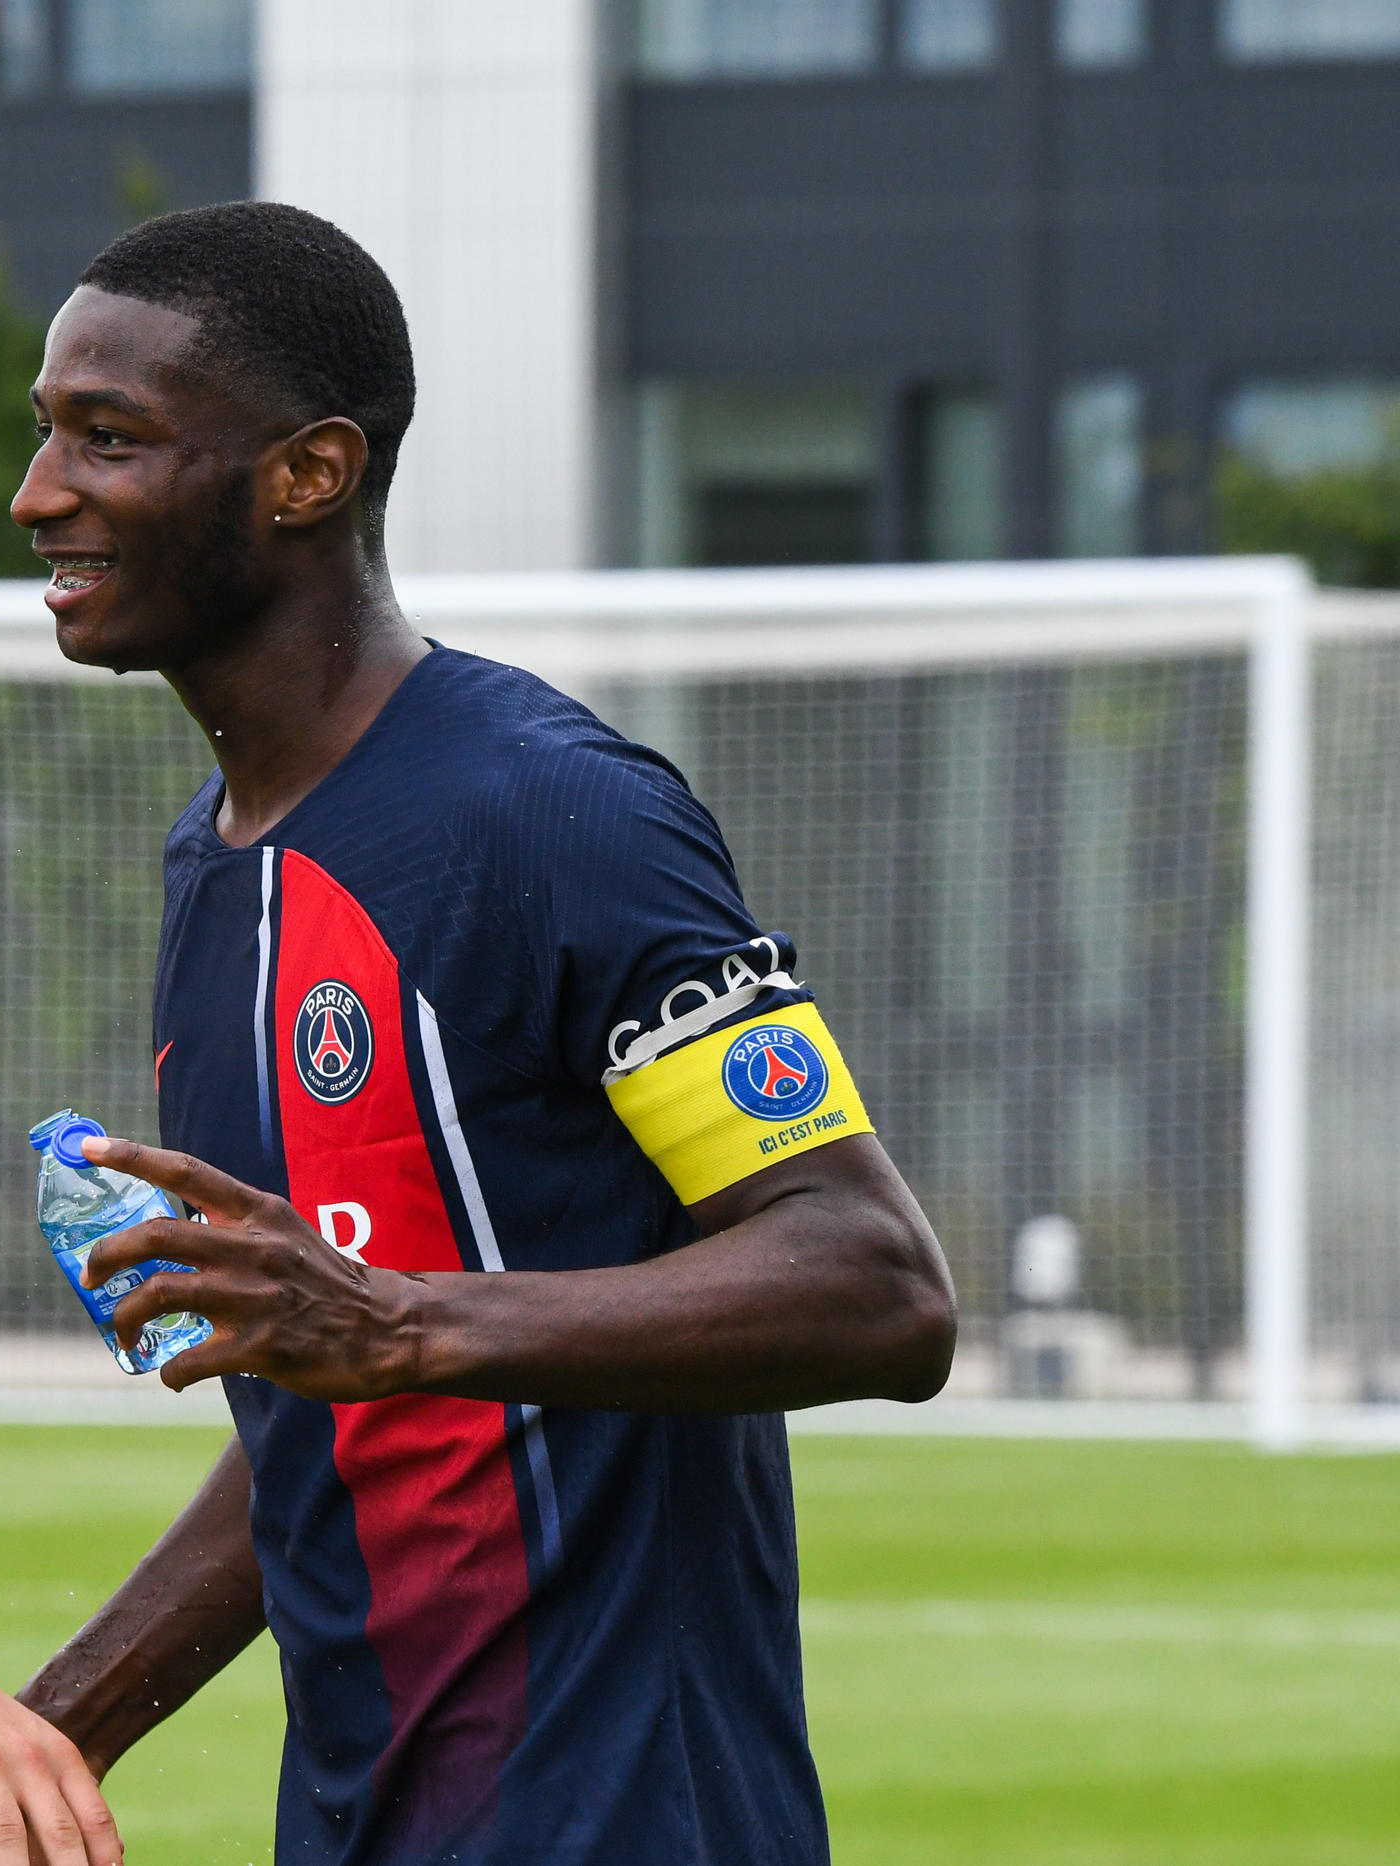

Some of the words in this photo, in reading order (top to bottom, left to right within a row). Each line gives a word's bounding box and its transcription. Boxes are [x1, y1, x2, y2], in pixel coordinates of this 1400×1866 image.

[305, 988, 354, 1017] PARIS
[733, 1031, 794, 1062] PARIS
[758, 1135, 778, 1155] ICI
[778, 1121, 813, 1146] C'EST
[813, 1109, 848, 1132] PARIS
